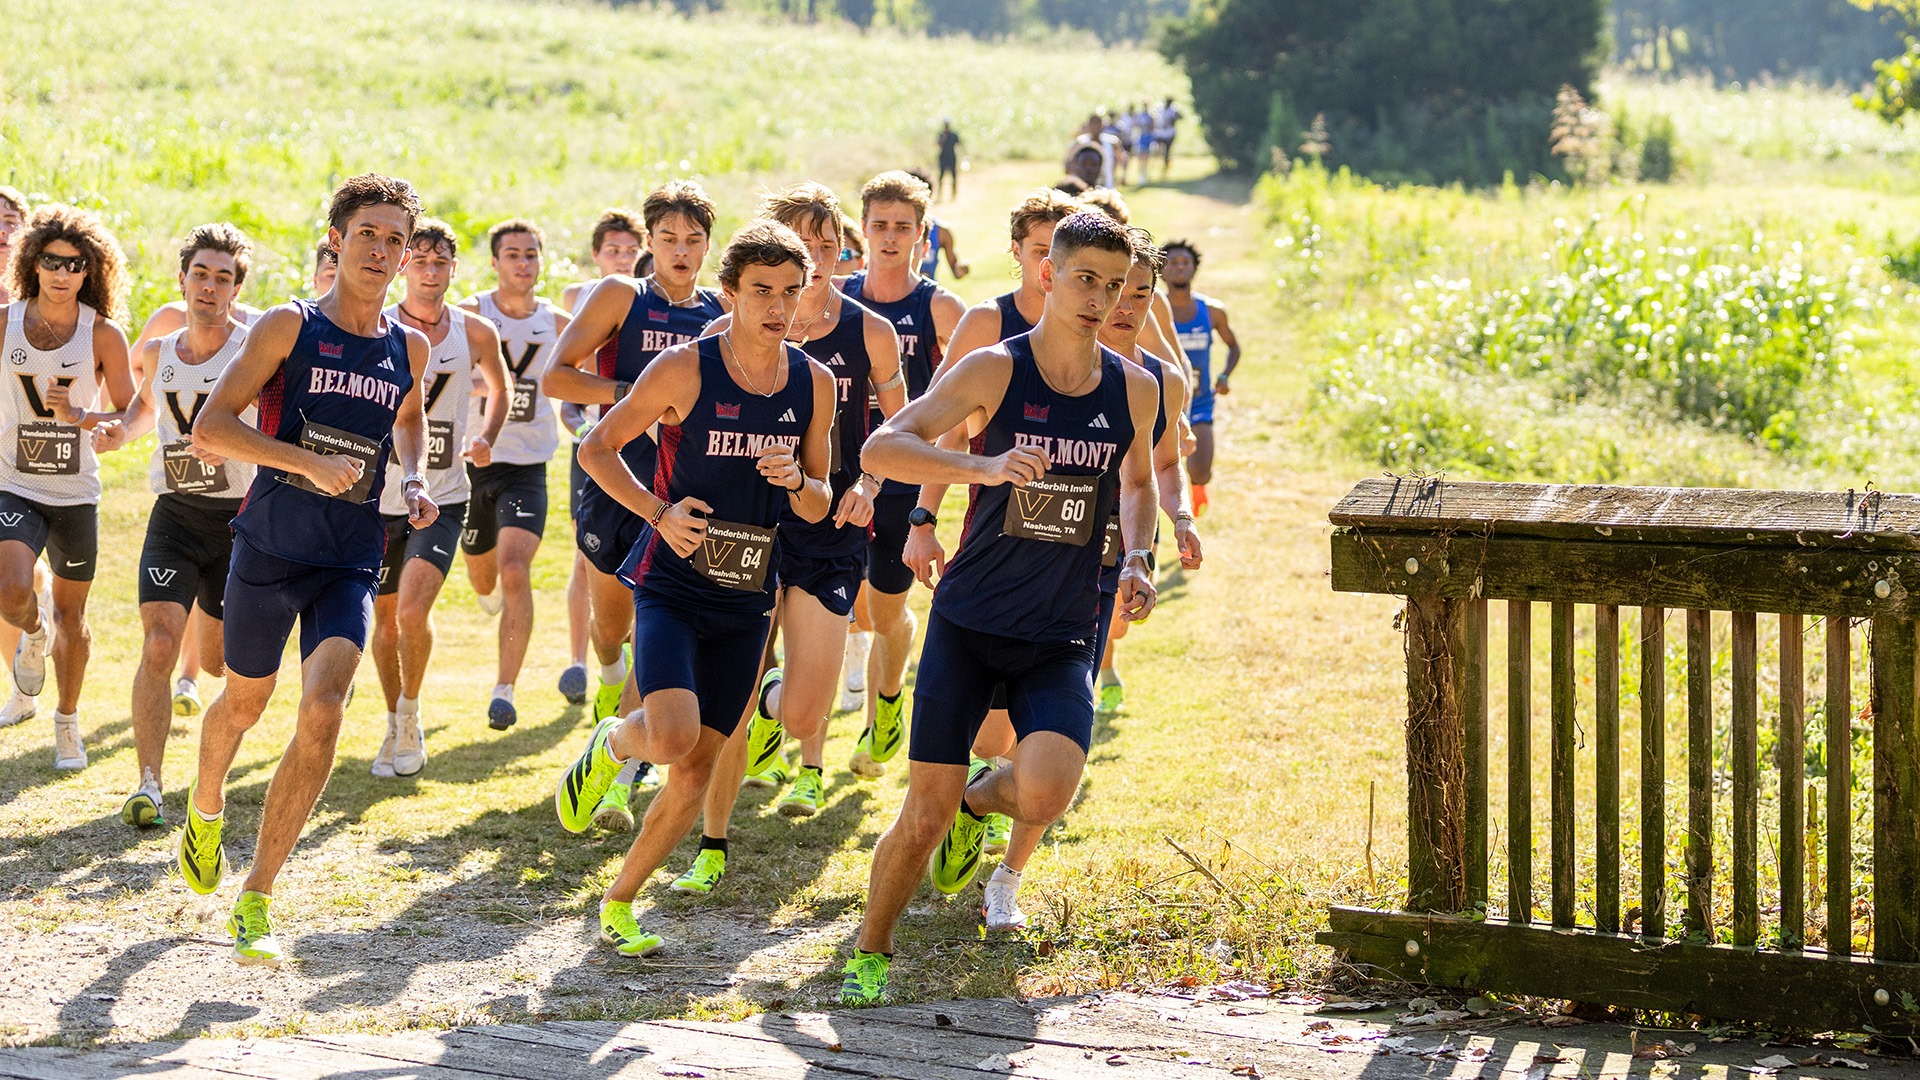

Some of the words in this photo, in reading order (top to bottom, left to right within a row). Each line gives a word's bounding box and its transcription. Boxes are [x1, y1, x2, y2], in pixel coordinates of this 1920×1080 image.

[641, 330, 699, 352] BELM
[308, 367, 400, 411] BELMONT
[513, 391, 530, 409] 25
[55, 442, 72, 460] 19
[308, 429, 353, 449] Vanderbilt
[353, 442, 376, 456] Invite
[428, 436, 445, 454] 20
[1026, 481, 1069, 492] anderbilt
[1070, 484, 1094, 492] Invite
[1060, 499, 1086, 522] 60
[708, 526, 750, 540] Vanderbilt
[750, 533, 771, 543] Invite
[1023, 521, 1062, 533] Nashville,
[1064, 526, 1076, 535] TN
[1106, 522, 1118, 530] vite
[740, 546, 763, 569] 64
[708, 568, 741, 580] Nashville,
